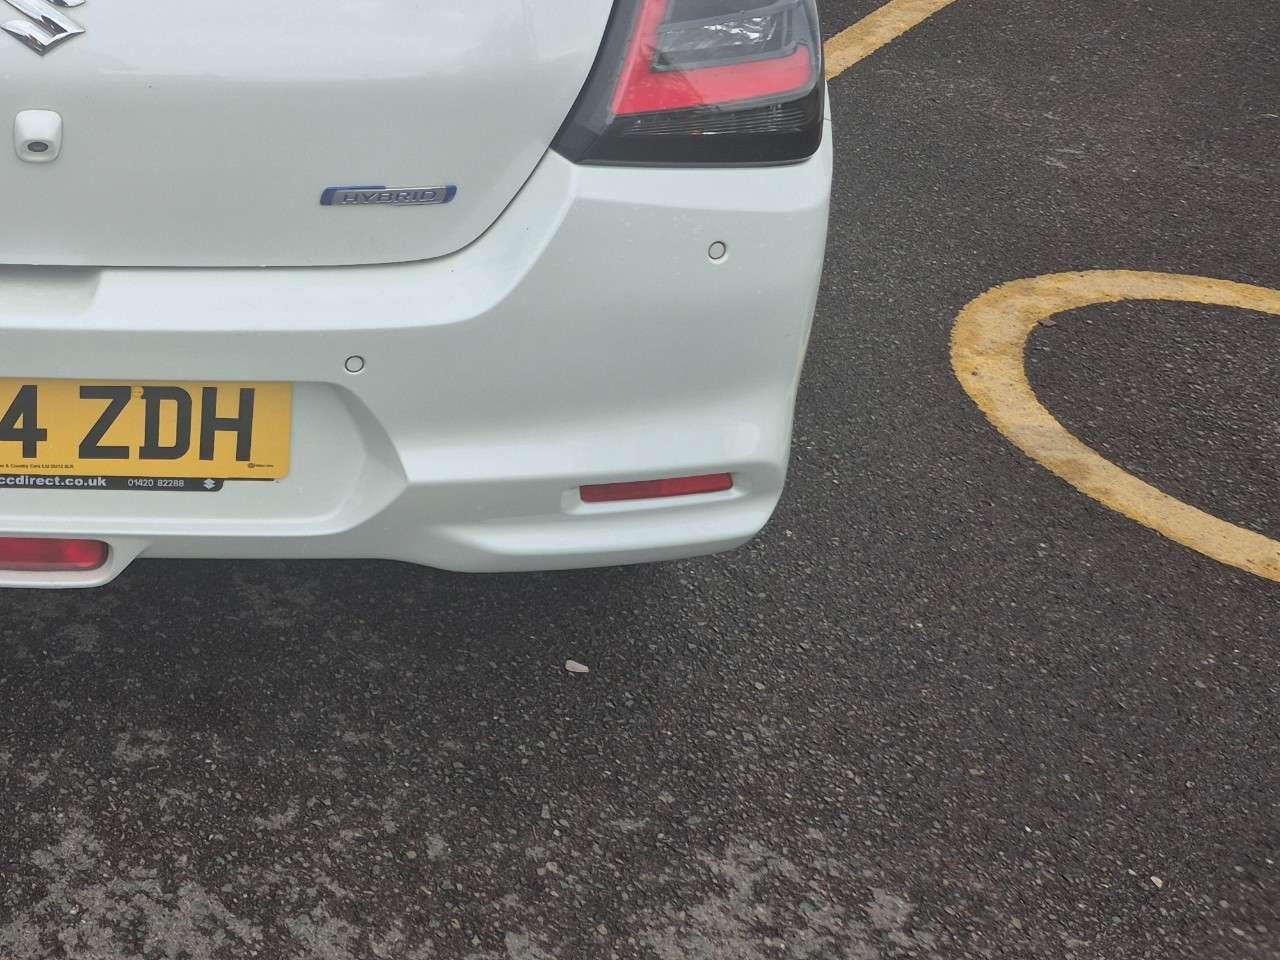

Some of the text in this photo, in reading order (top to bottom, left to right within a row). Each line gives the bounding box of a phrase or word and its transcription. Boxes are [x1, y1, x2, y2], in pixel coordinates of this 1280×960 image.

[340, 190, 438, 205] HYBRID
[78, 385, 256, 462] ZDH
[127, 478, 154, 487] 01420
[157, 479, 185, 488] 82288
